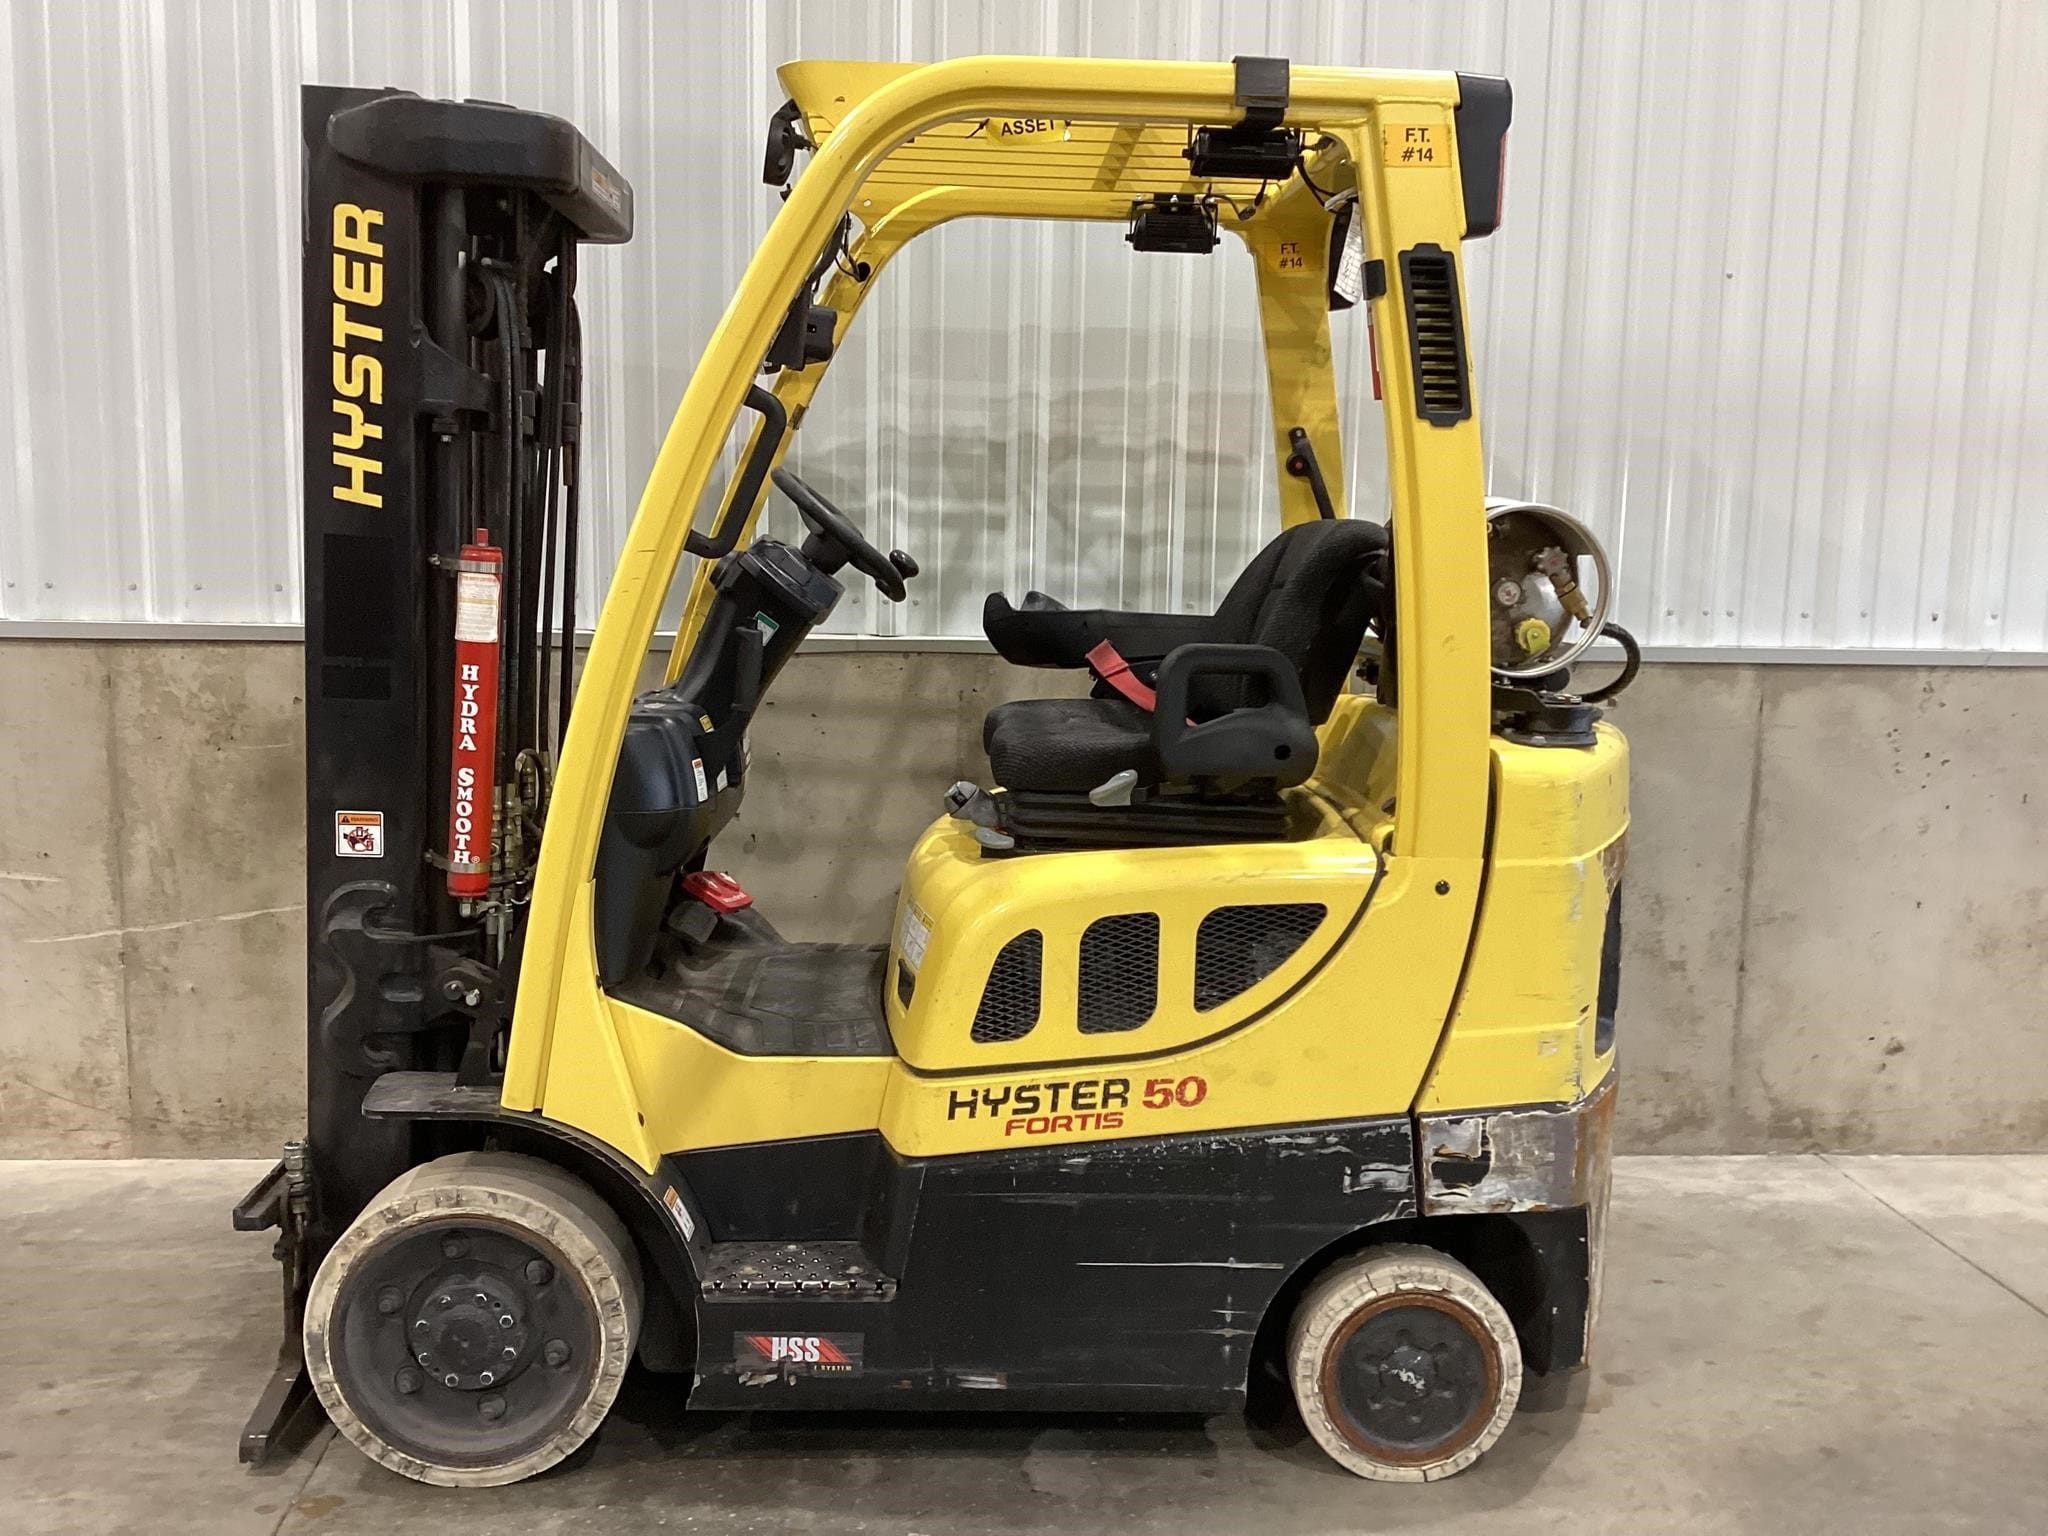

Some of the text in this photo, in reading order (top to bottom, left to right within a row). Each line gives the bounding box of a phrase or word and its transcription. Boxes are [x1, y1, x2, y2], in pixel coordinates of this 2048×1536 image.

[1405, 127, 1431, 143] F.T.
[1401, 147, 1434, 162] #14
[1279, 256, 1303, 268] #14
[333, 202, 384, 509] HYSTER
[458, 664, 480, 751] HYDRA
[947, 1075, 1208, 1121] HYSTER 50
[1004, 1111, 1125, 1137] FORTIS
[771, 1336, 821, 1362] HSS
